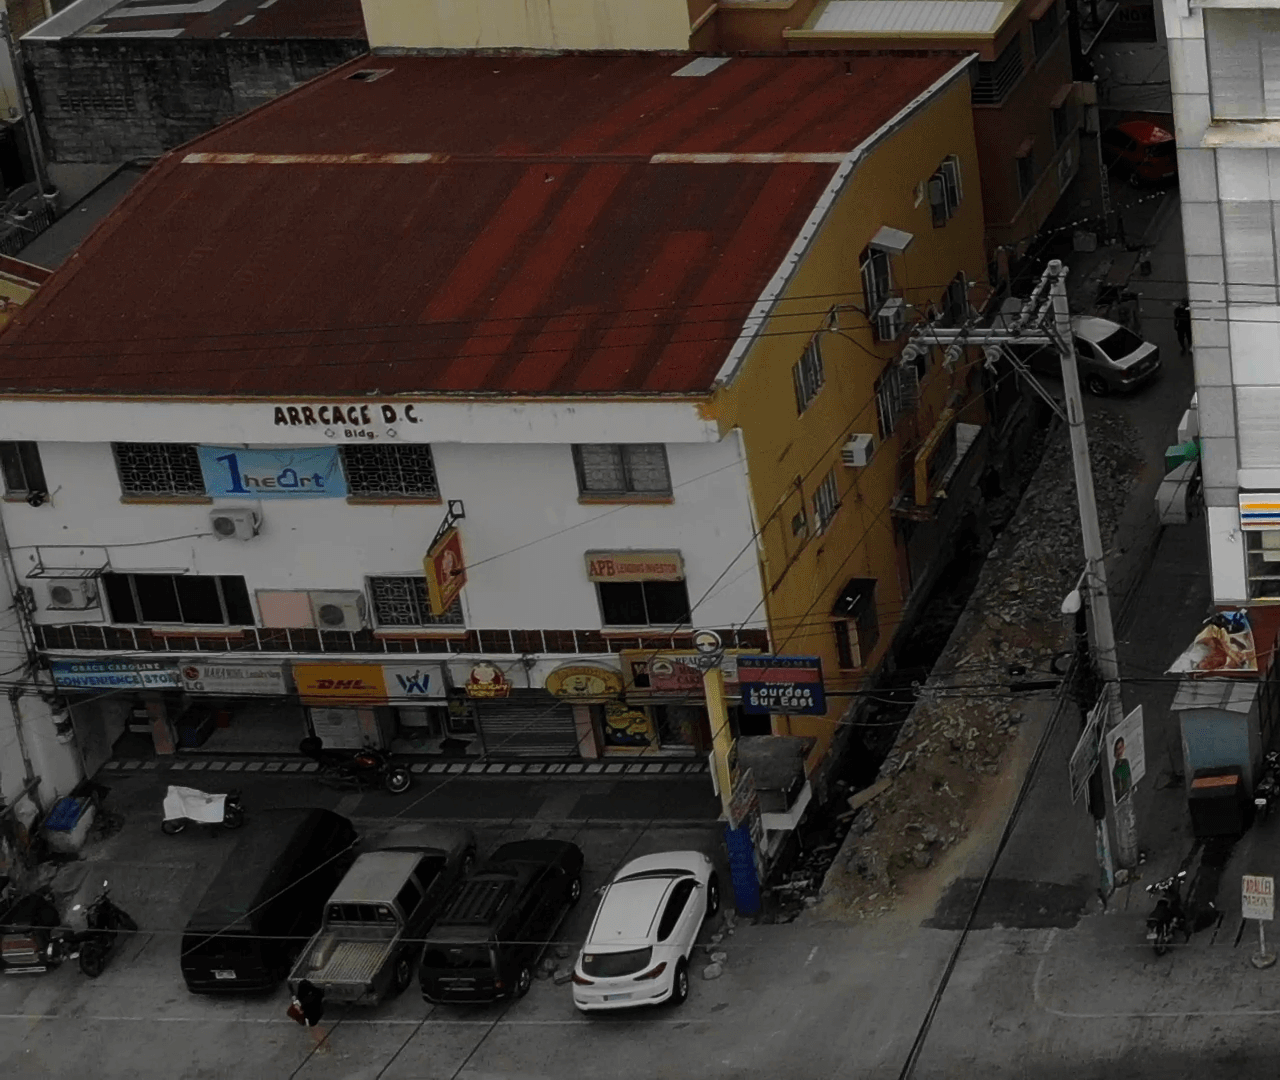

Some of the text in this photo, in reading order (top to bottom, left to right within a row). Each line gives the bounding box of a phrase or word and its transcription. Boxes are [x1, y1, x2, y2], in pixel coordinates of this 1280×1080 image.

[274, 405, 371, 426] ARRCAGE
[344, 428, 379, 439] Bldg.
[742, 659, 811, 667] WELCOME
[314, 679, 366, 690] DHL
[750, 687, 811, 697] Lourdes
[750, 696, 814, 707] Sur East
